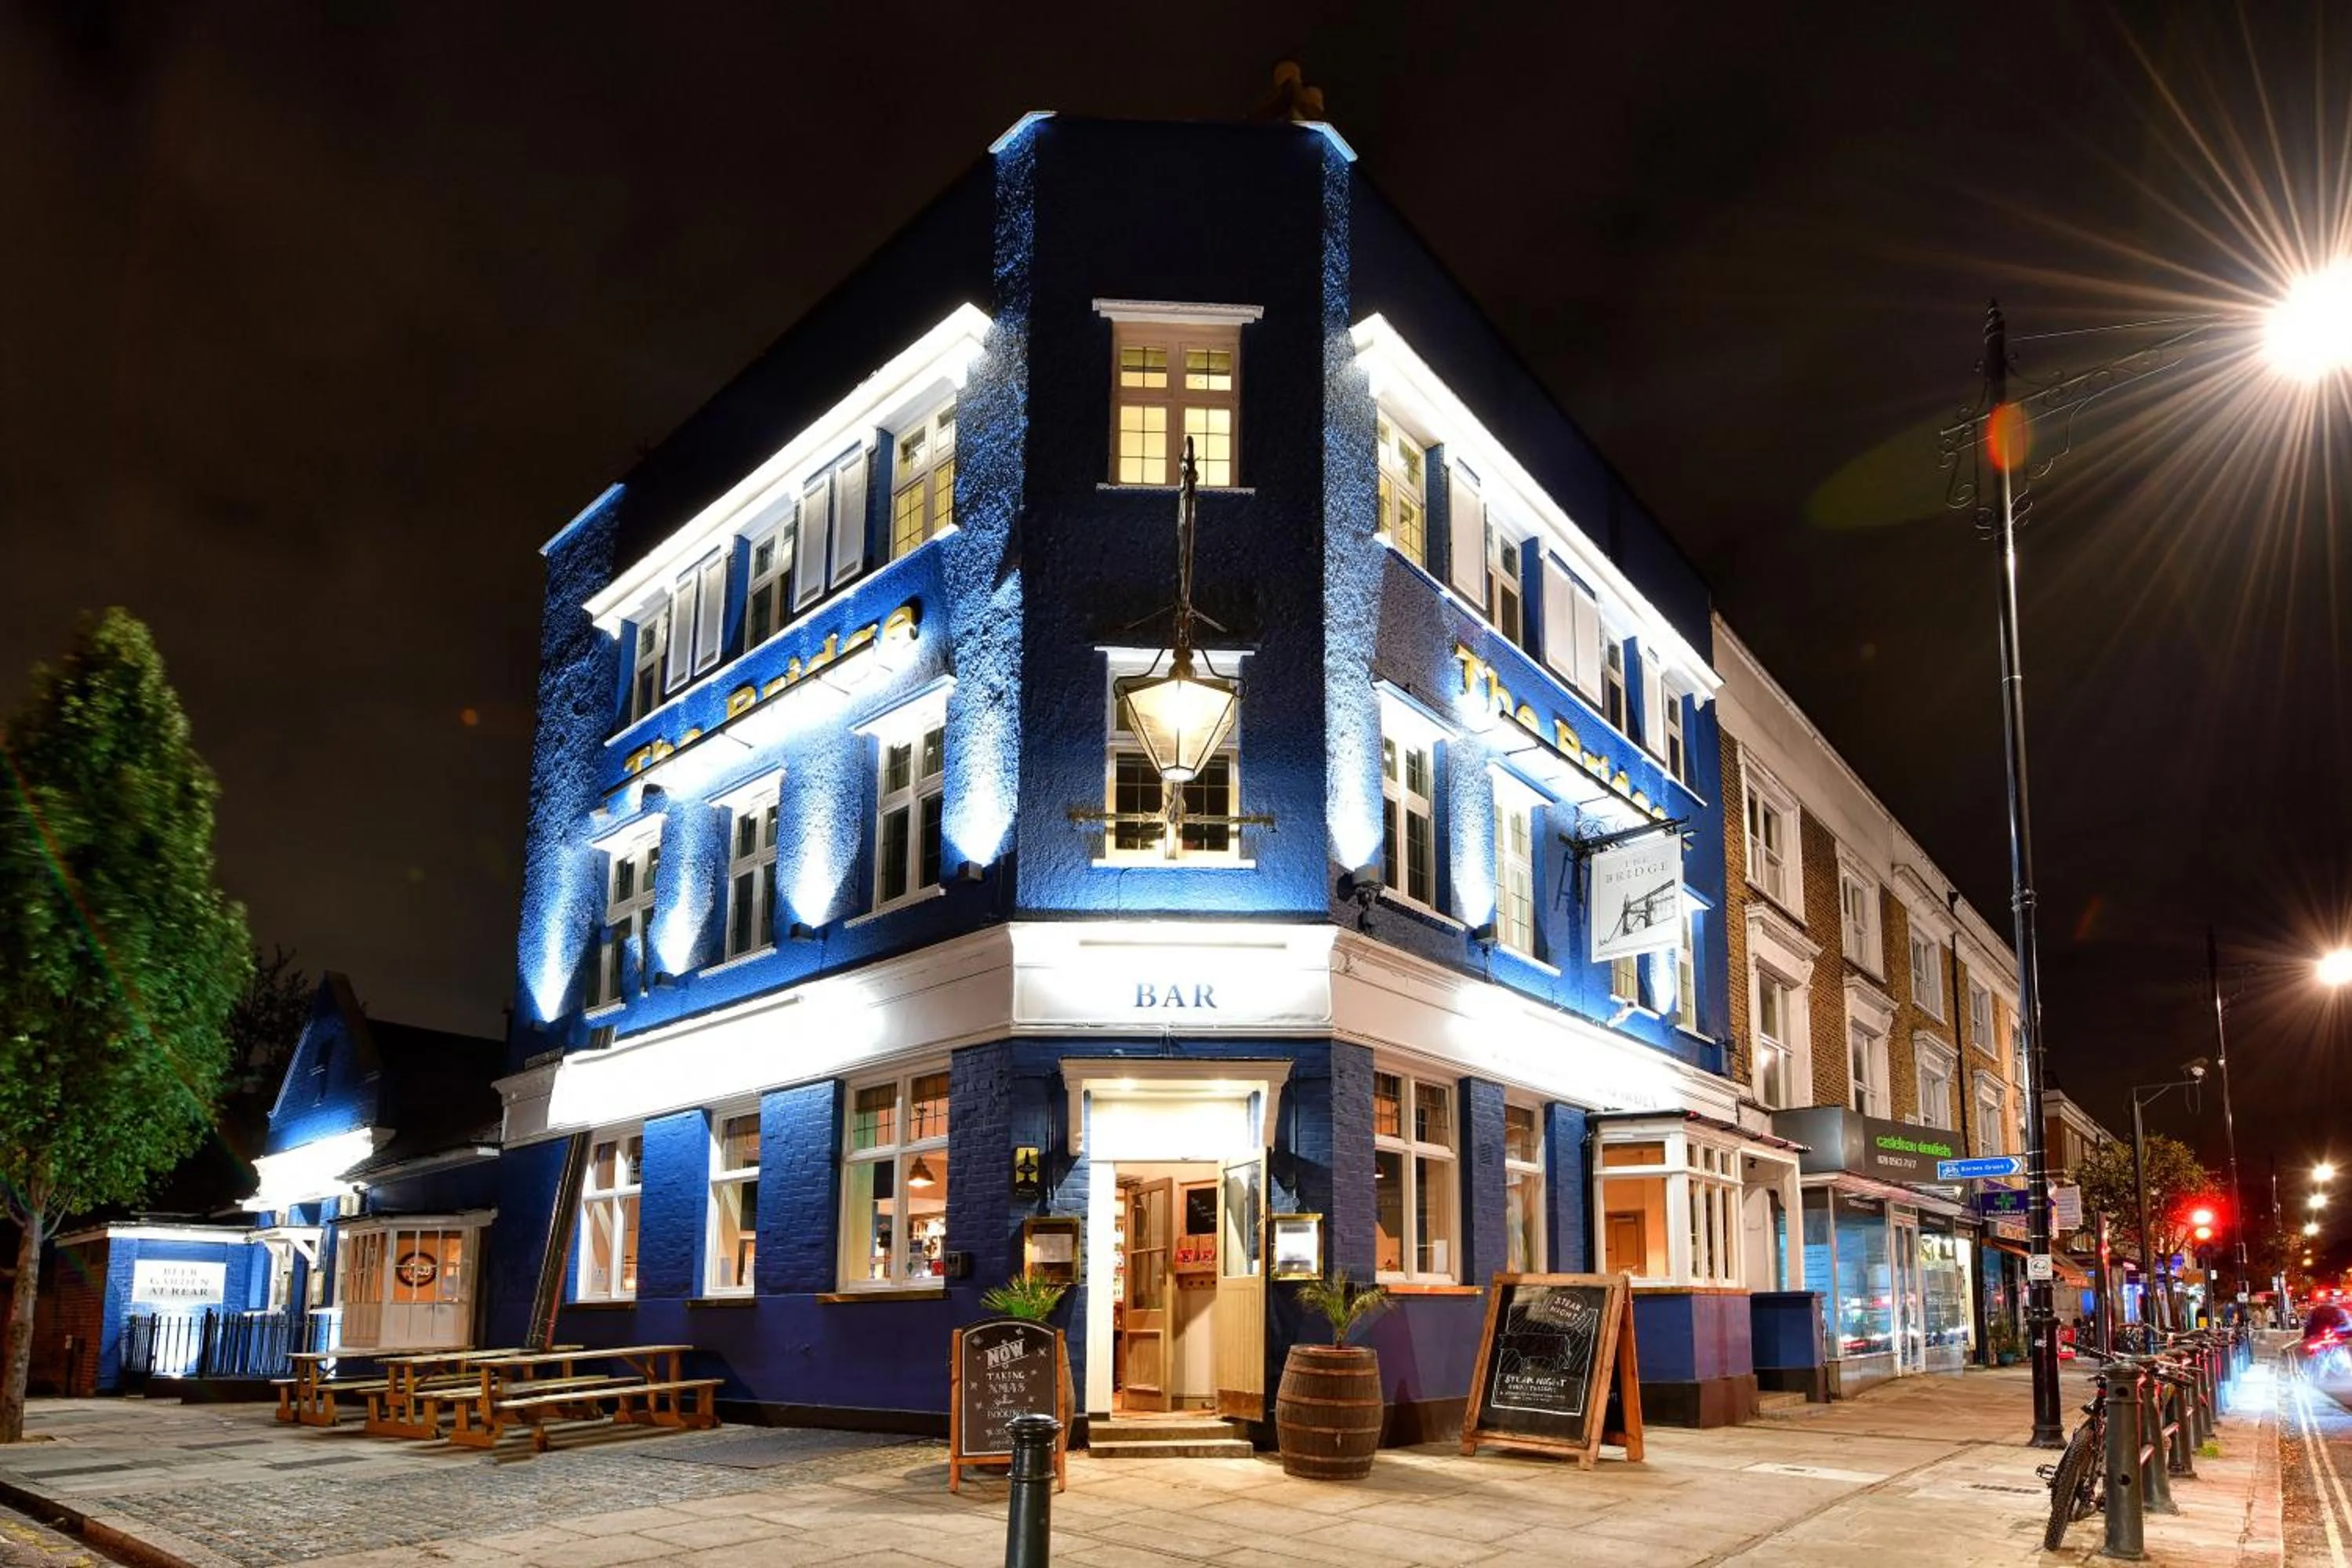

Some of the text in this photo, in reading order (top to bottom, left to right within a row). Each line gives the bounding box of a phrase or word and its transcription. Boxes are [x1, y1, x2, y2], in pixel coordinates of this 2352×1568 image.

[1605, 859, 1668, 884] BRIDGE
[1134, 983, 1218, 1009] BAR
[1918, 1141, 1952, 1158] dentists
[163, 1268, 198, 1277] BEER
[149, 1276, 209, 1286] GARDEN
[148, 1287, 208, 1298] AT REAR
[987, 1340, 1024, 1368] NOW
[987, 1370, 1025, 1381] TAKING
[1504, 1374, 1534, 1385] STEAK
